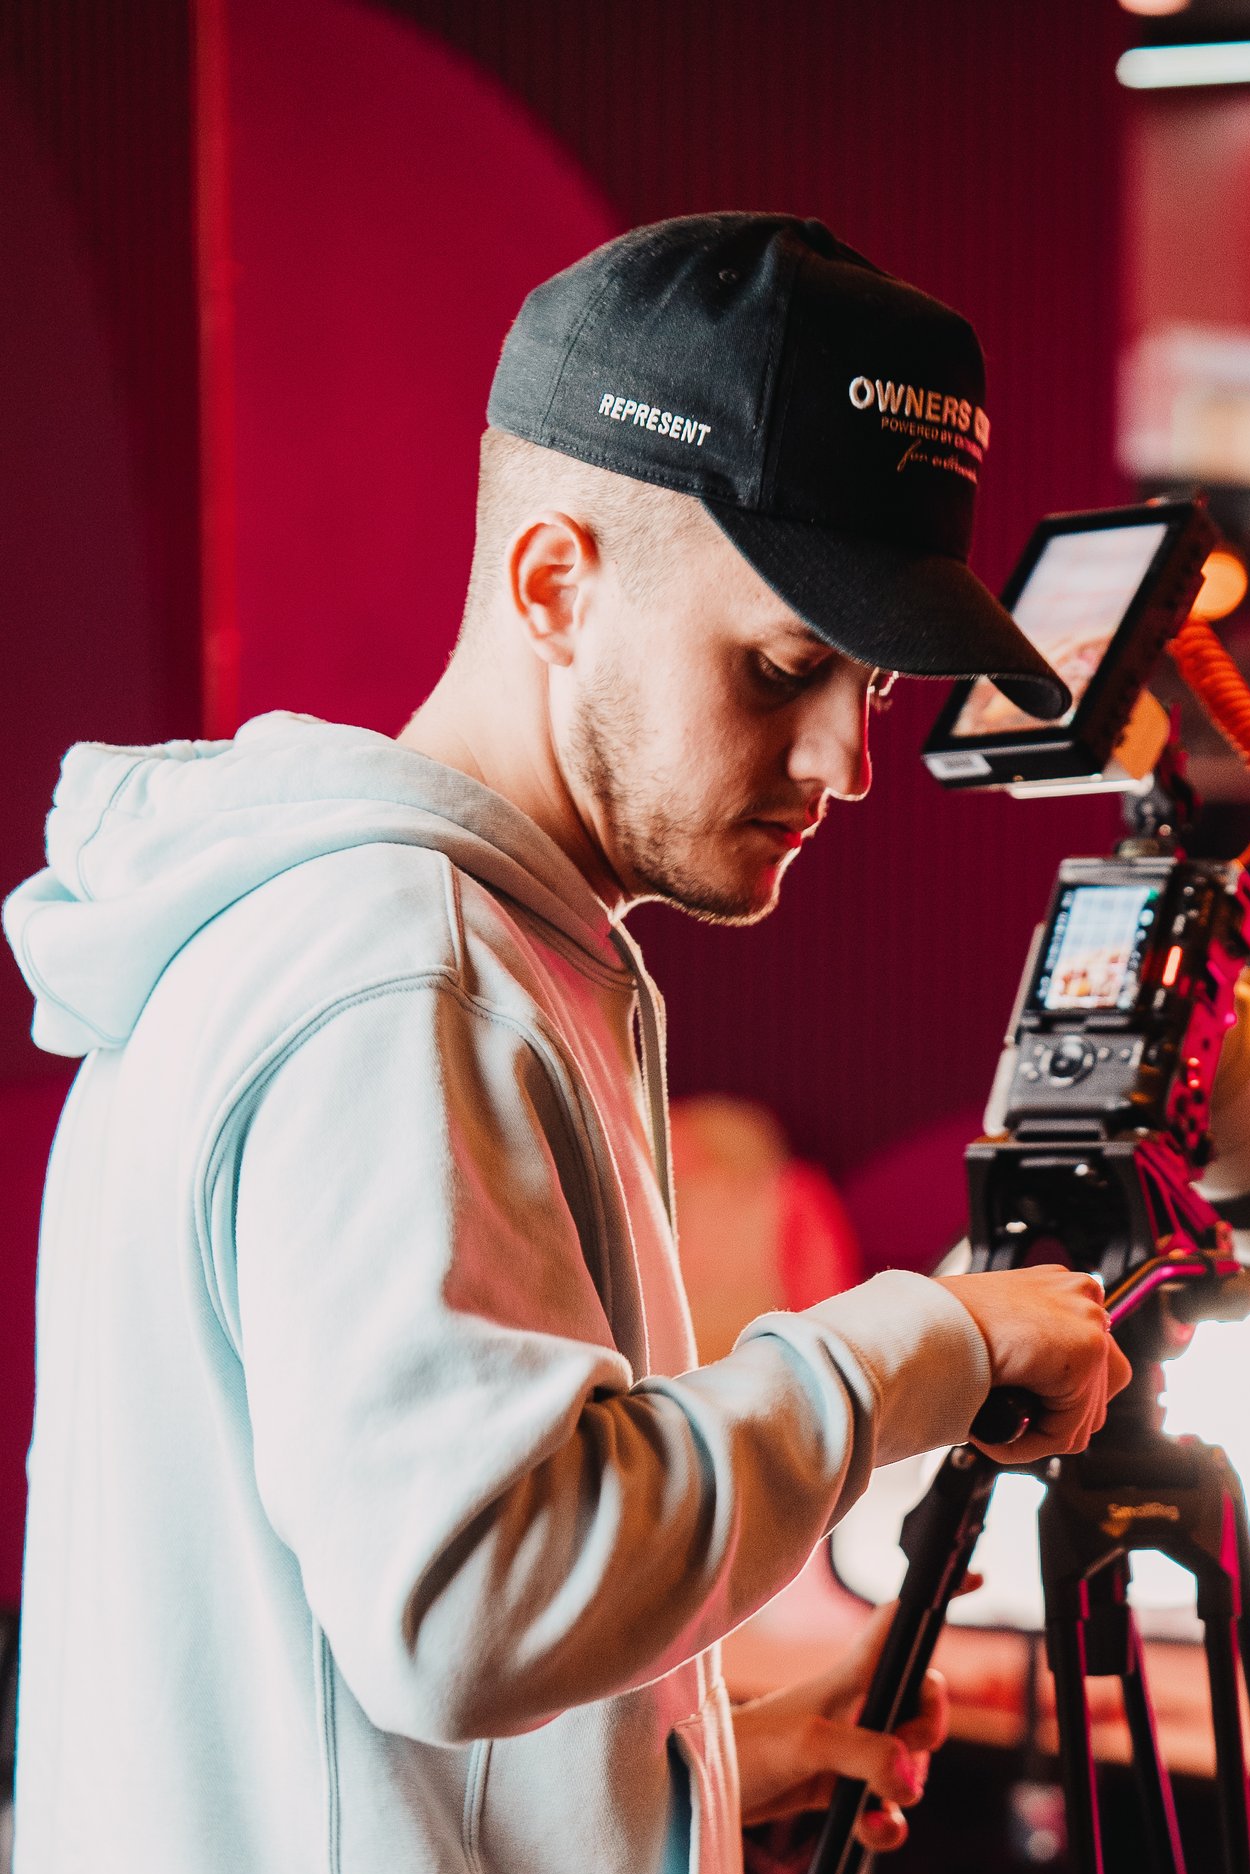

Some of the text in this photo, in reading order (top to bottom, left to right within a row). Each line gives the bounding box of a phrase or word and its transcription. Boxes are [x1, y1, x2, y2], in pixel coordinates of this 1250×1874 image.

[598, 393, 712, 446] REPRESENT
[848, 375, 973, 433] OWNERS
[881, 416, 953, 445] POWERED BY
